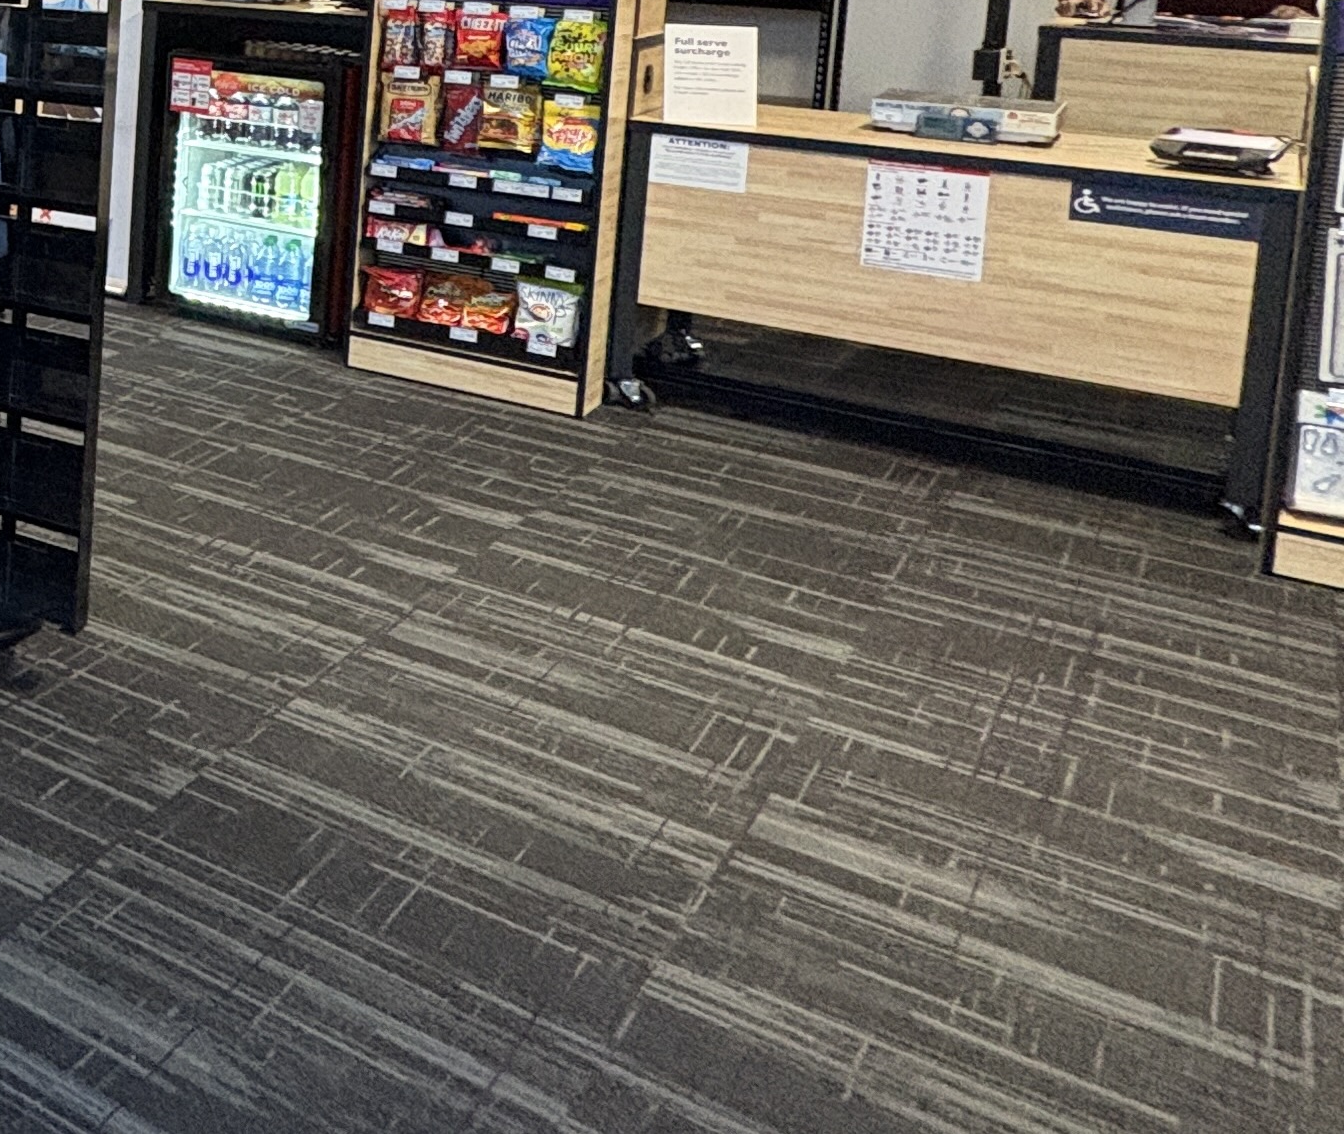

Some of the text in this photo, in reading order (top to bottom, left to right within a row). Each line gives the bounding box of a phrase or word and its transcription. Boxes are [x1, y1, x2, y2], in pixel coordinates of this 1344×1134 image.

[674, 37, 728, 47] Full serve
[674, 47, 731, 58] surcharge
